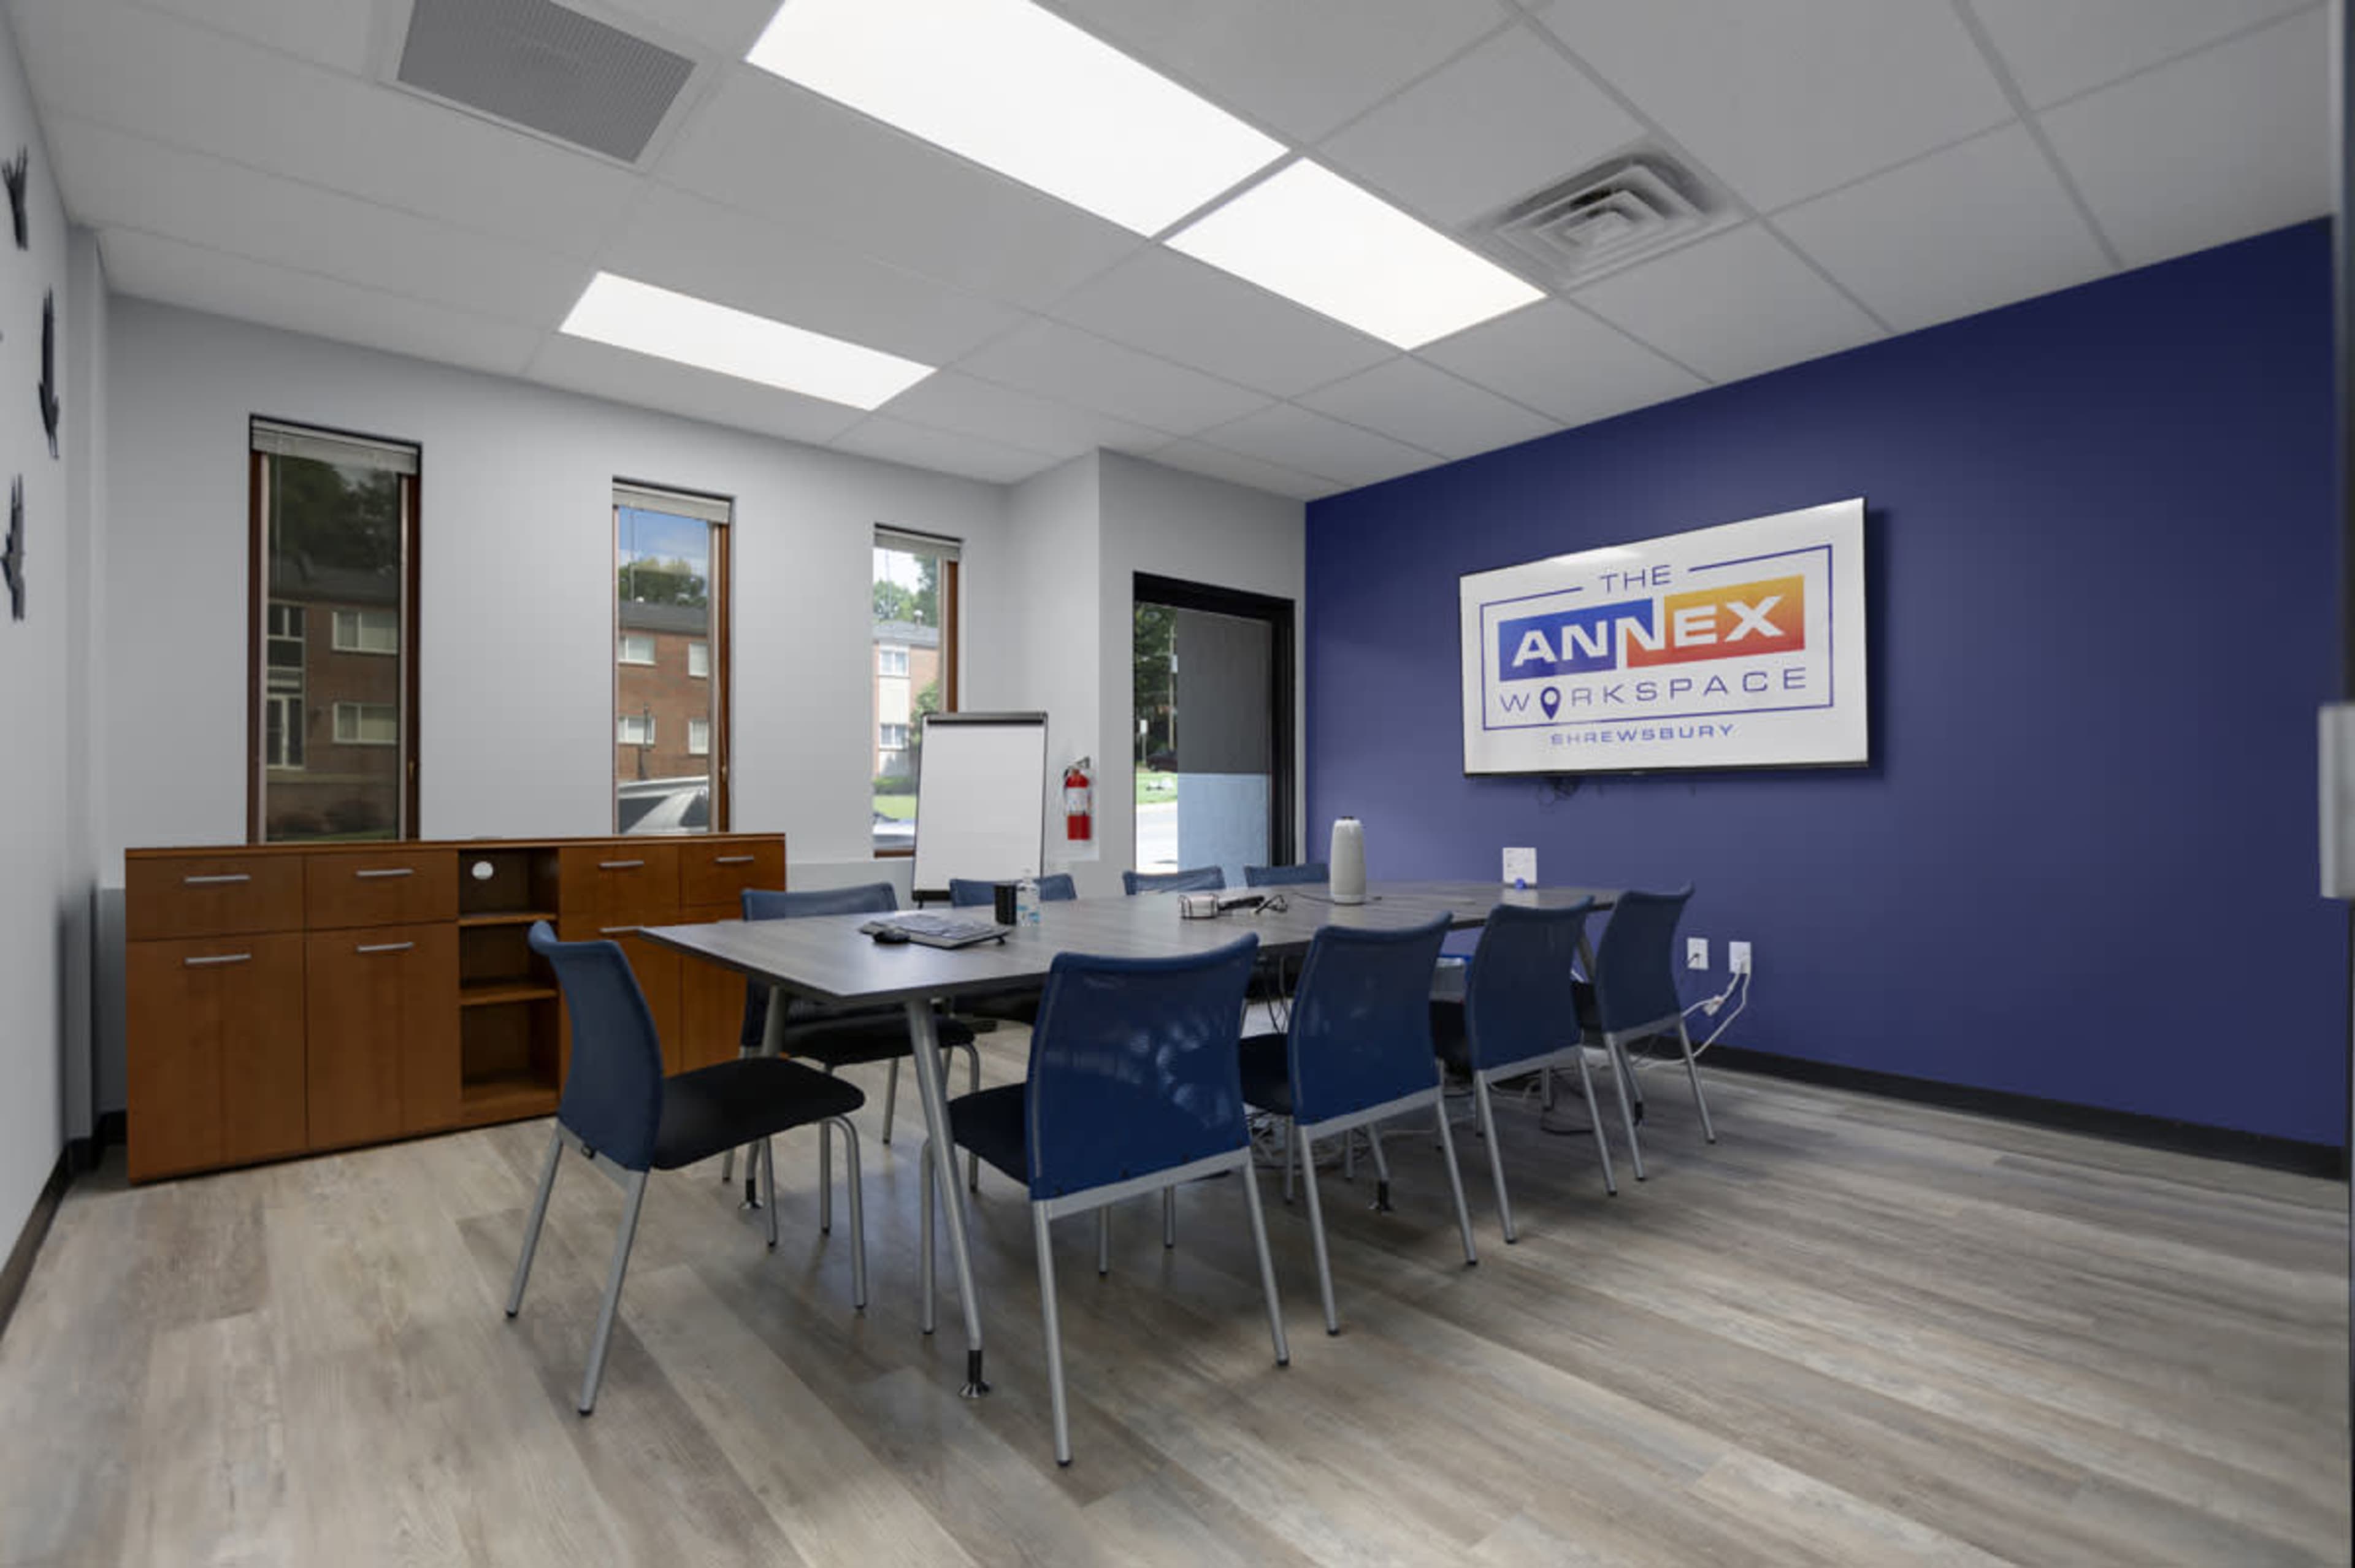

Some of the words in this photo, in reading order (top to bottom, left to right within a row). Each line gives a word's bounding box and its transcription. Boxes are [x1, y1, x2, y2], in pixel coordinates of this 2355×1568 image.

[1599, 564, 1671, 594] THE
[1512, 594, 1785, 668] ANNEX
[1551, 724, 1734, 745] SHREWSBURY
